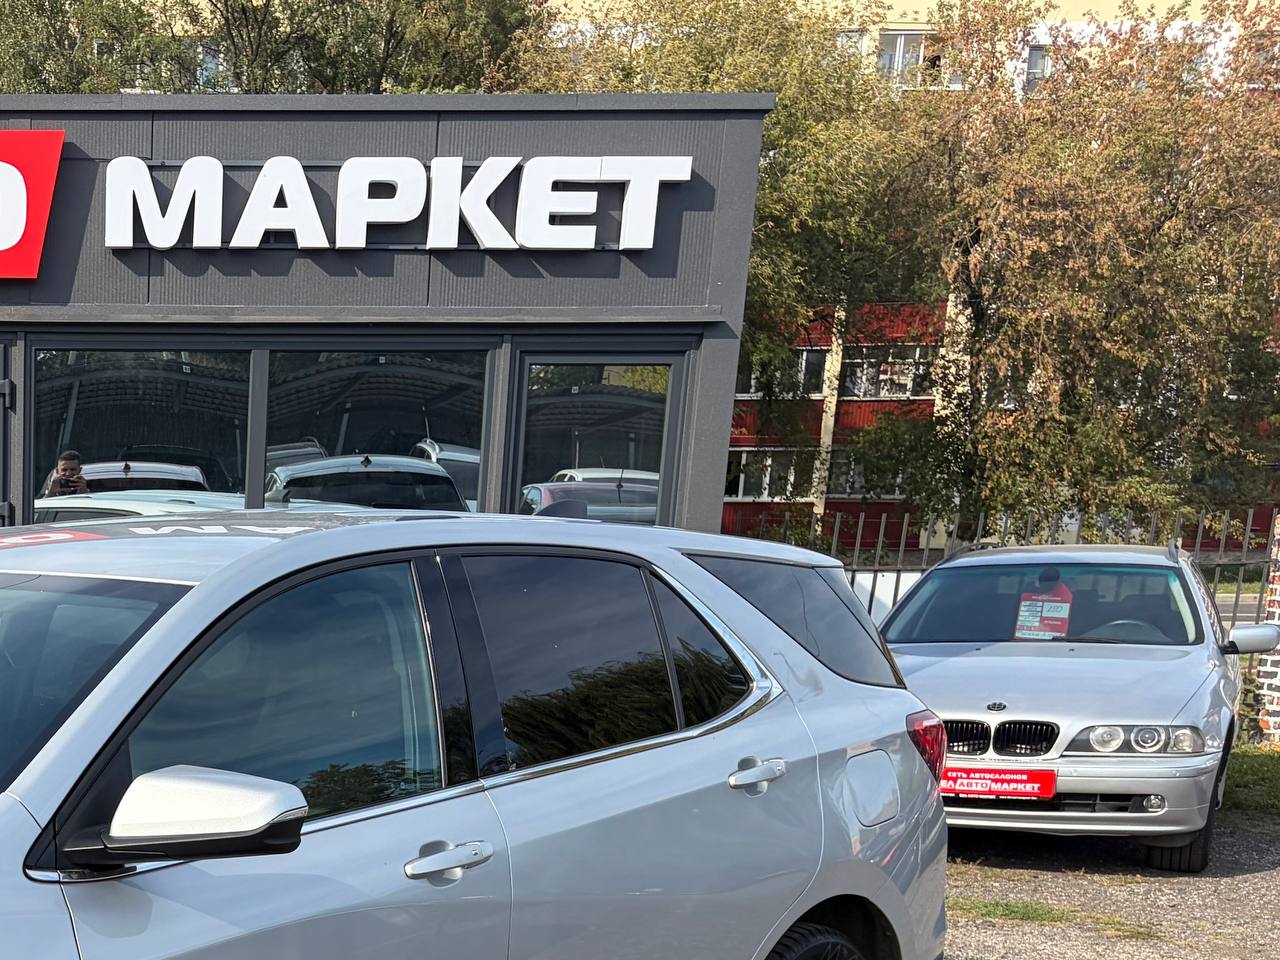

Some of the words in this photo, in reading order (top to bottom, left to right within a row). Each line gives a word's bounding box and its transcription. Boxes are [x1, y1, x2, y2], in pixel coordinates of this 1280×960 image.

[105, 155, 693, 251] МАРКЕТ
[969, 772, 1028, 780] АВТОСАЛОНОВ
[940, 780, 955, 788] ЕЛ
[957, 780, 989, 789] АВТО
[990, 782, 1041, 791] МАРКЕТ
